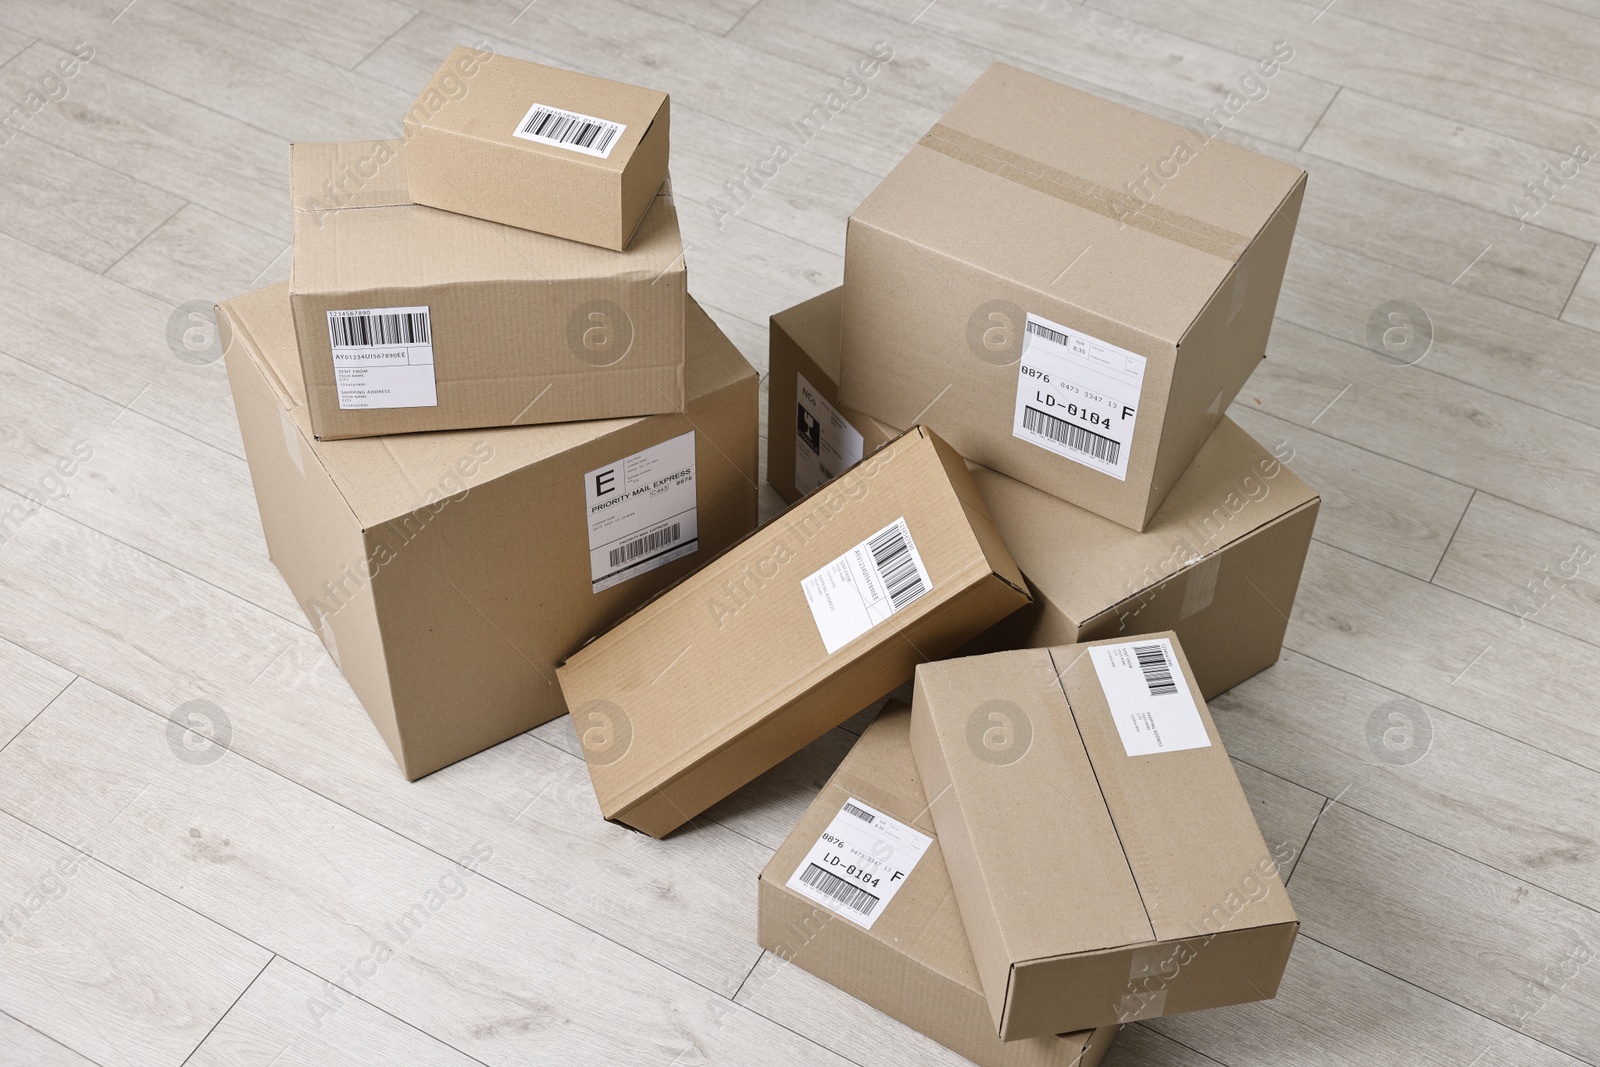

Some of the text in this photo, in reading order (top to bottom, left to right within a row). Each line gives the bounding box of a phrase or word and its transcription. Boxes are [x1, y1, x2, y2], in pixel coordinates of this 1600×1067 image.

[1036, 390, 1111, 430] LD-0104
[1084, 391, 1103, 403] 3347
[1107, 401, 1117, 409] 13
[1121, 405, 1135, 423] F
[592, 492, 631, 514] PRIORITY
[633, 484, 651, 497] MAIL
[654, 468, 691, 488] EXPRESS
[596, 469, 616, 497] E
[823, 852, 881, 888] LD-0104
[866, 857, 882, 868] 3347
[890, 871, 905, 885] F
